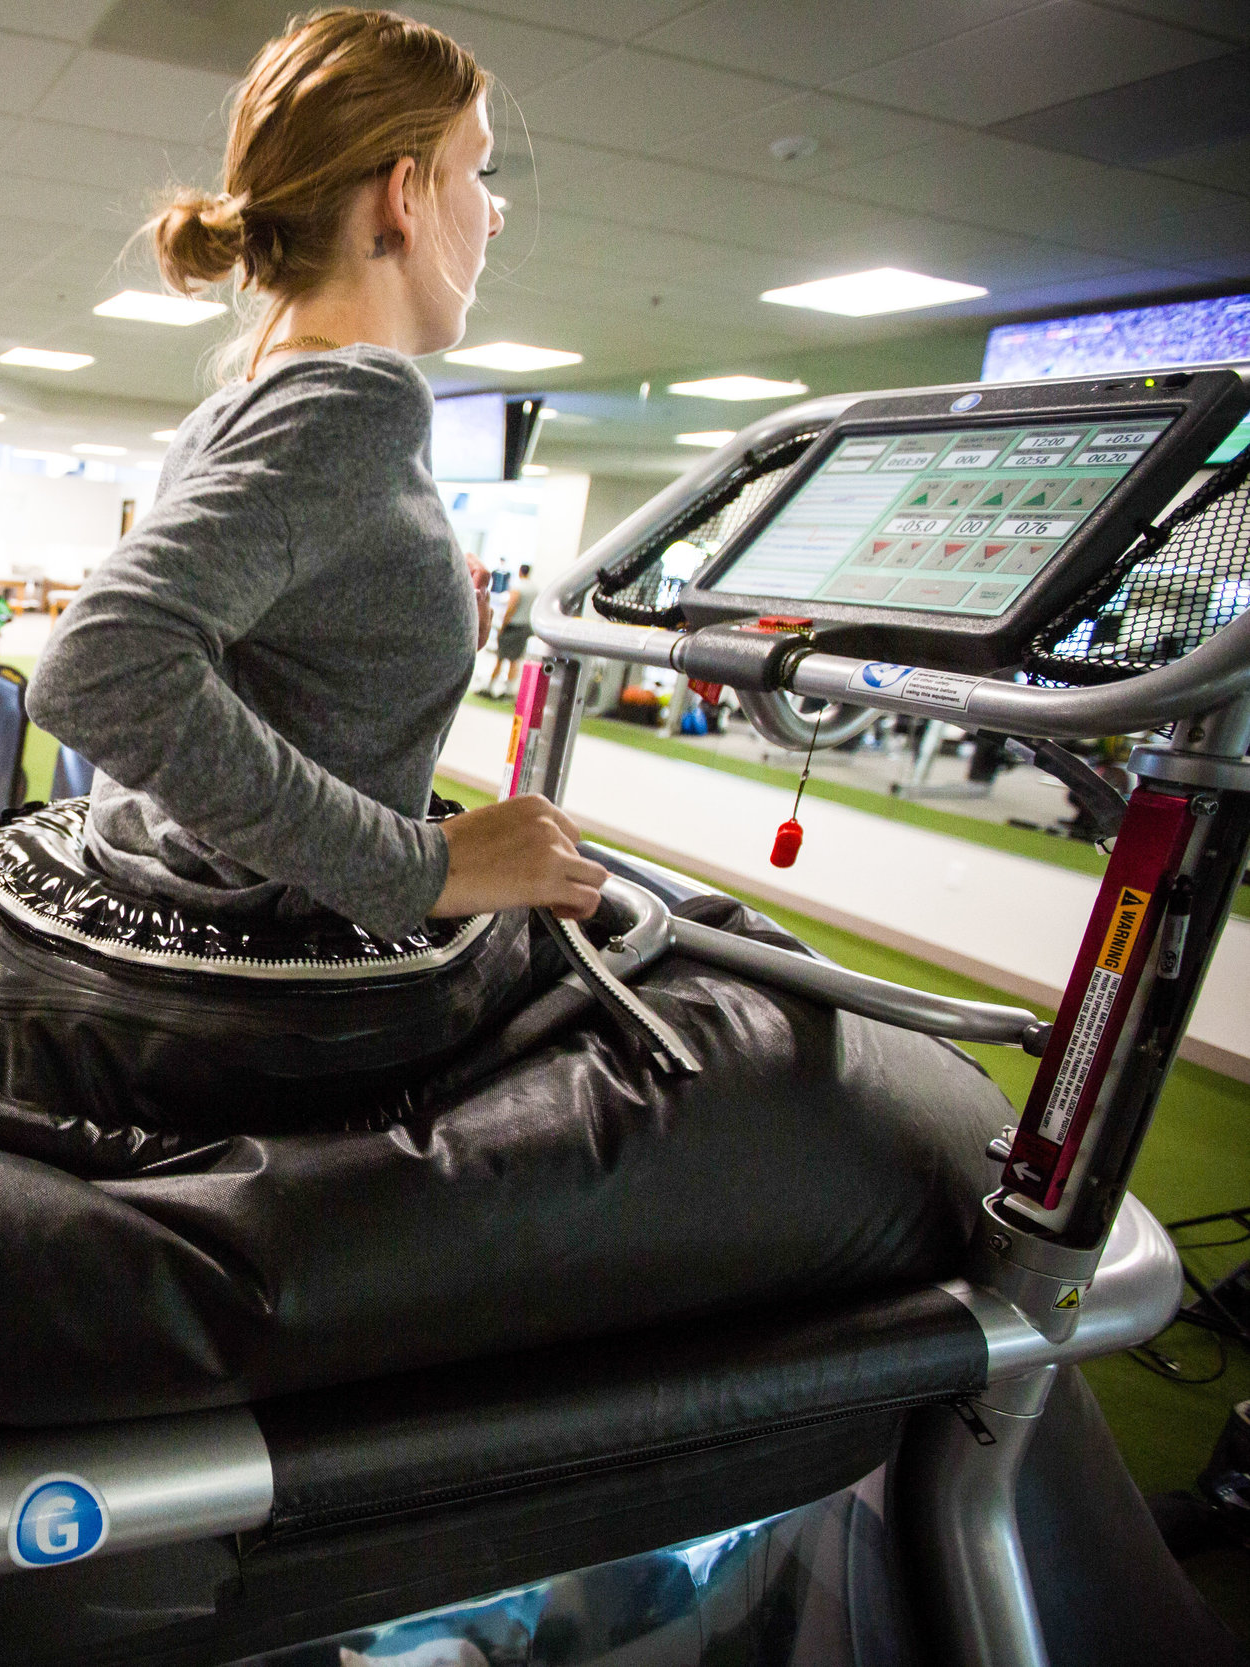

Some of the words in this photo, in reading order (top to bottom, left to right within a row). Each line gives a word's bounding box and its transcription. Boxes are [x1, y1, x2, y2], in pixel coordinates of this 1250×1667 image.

[1031, 437, 1066, 447] 12:00
[1105, 434, 1145, 444] +05.0
[955, 455, 981, 465] 000
[1015, 456, 1050, 465] 02:58
[1088, 453, 1127, 463] 00.20
[960, 521, 983, 533] 00
[1014, 521, 1052, 535] 076
[1103, 907, 1137, 969] WARNING
[1087, 969, 1102, 994] FAILURE
[1098, 973, 1111, 991] PRIOR
[1109, 976, 1120, 990] THIS
[1085, 993, 1094, 1002] TO
[1095, 991, 1104, 1000] TO
[1101, 990, 1115, 1012] SAFETY
[1080, 1001, 1091, 1014] USE
[1084, 999, 1101, 1031] OPERATION
[1097, 1011, 1108, 1024] BAR
[1073, 1013, 1087, 1034] SAFETY
[1081, 1030, 1090, 1040] OF
[1091, 1023, 1103, 1041] MUST
[1069, 1034, 1079, 1047] BAR
[1078, 1039, 1087, 1051] THE
[1088, 1039, 1097, 1048] BE
[1065, 1046, 1075, 1059] MAY
[1086, 1047, 1095, 1055] IN
[1067, 1050, 1084, 1080] G-TRAINER
[1082, 1054, 1092, 1067] THE
[1058, 1058, 1071, 1080] RESULT
[1076, 1065, 1088, 1084] DOWN
[1065, 1078, 1073, 1086] IN
[1061, 1085, 1071, 1098] ANY
[1071, 1083, 1082, 1097] AND
[1047, 1085, 1062, 1109] SERIOUS
[1064, 1095, 1078, 1118] LOCKED
[1055, 1116, 1070, 1142] POSITION
[35, 1495, 80, 1555] G
